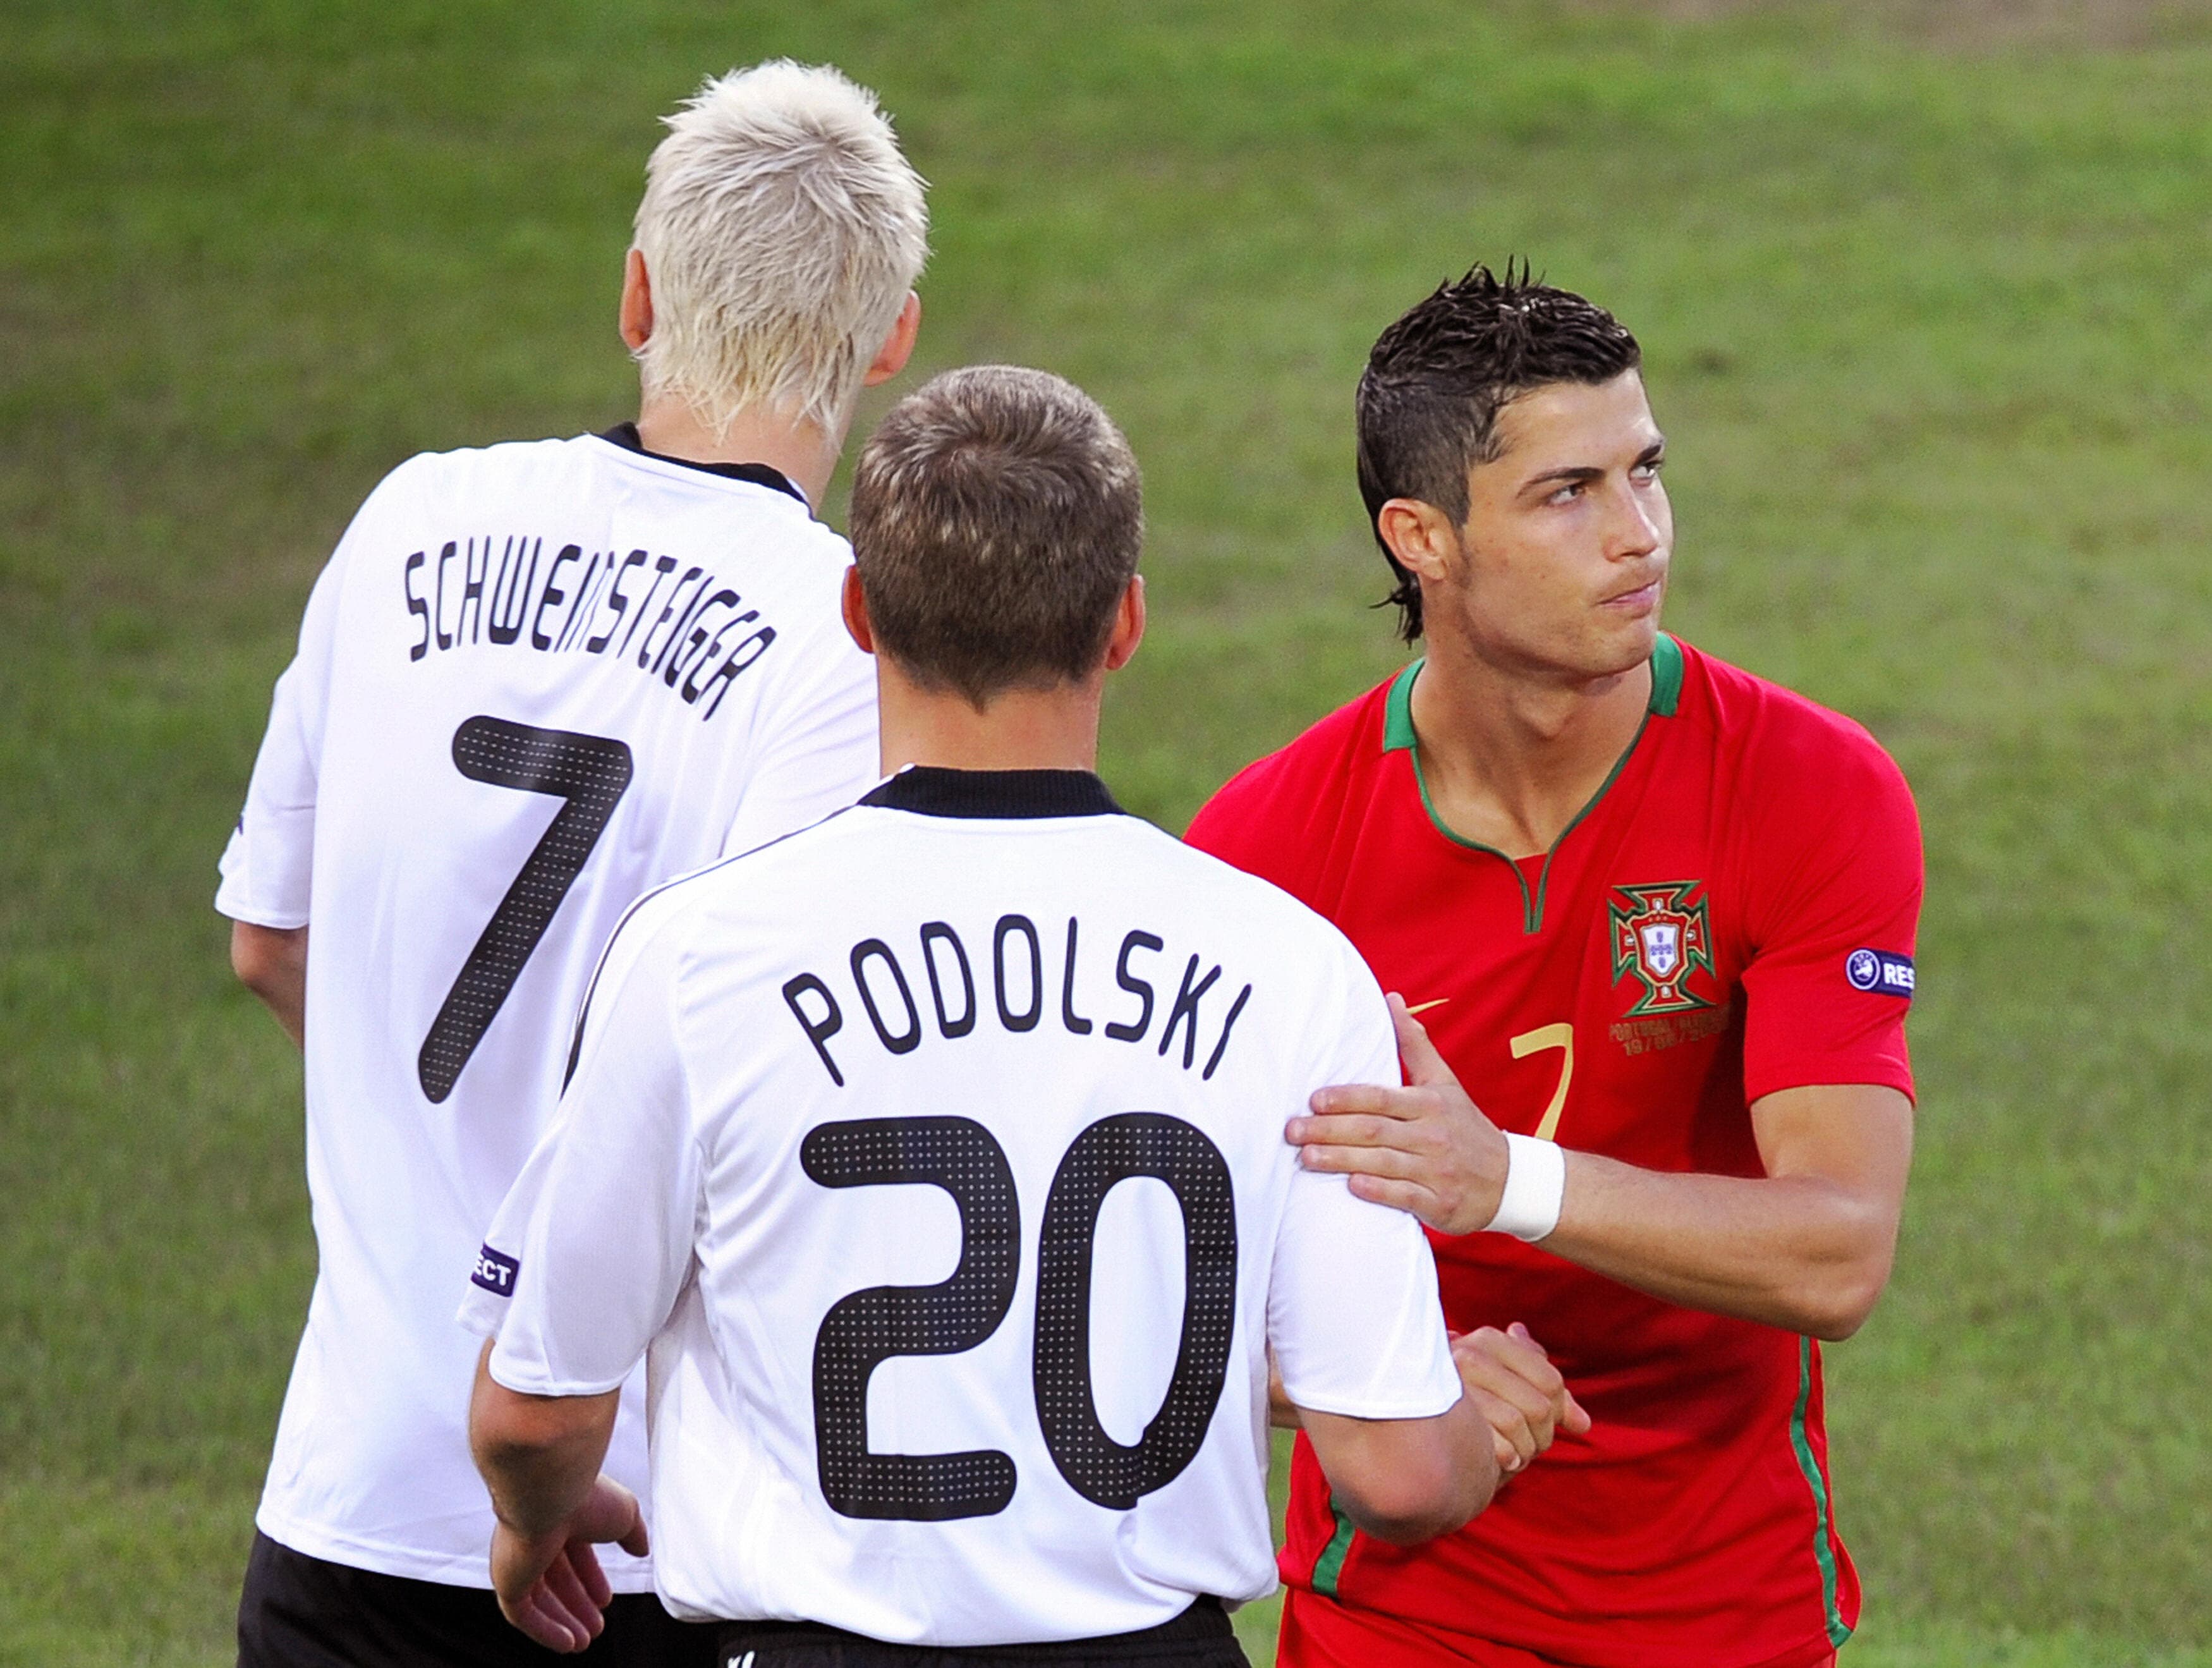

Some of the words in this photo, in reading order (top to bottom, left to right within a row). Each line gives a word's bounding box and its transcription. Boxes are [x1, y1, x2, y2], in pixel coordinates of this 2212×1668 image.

[417, 714, 633, 1104] 7
[781, 913, 1252, 1088] PODOLSKI
[1510, 1022, 1574, 1142] 7
[799, 1112, 1238, 1522] 20
